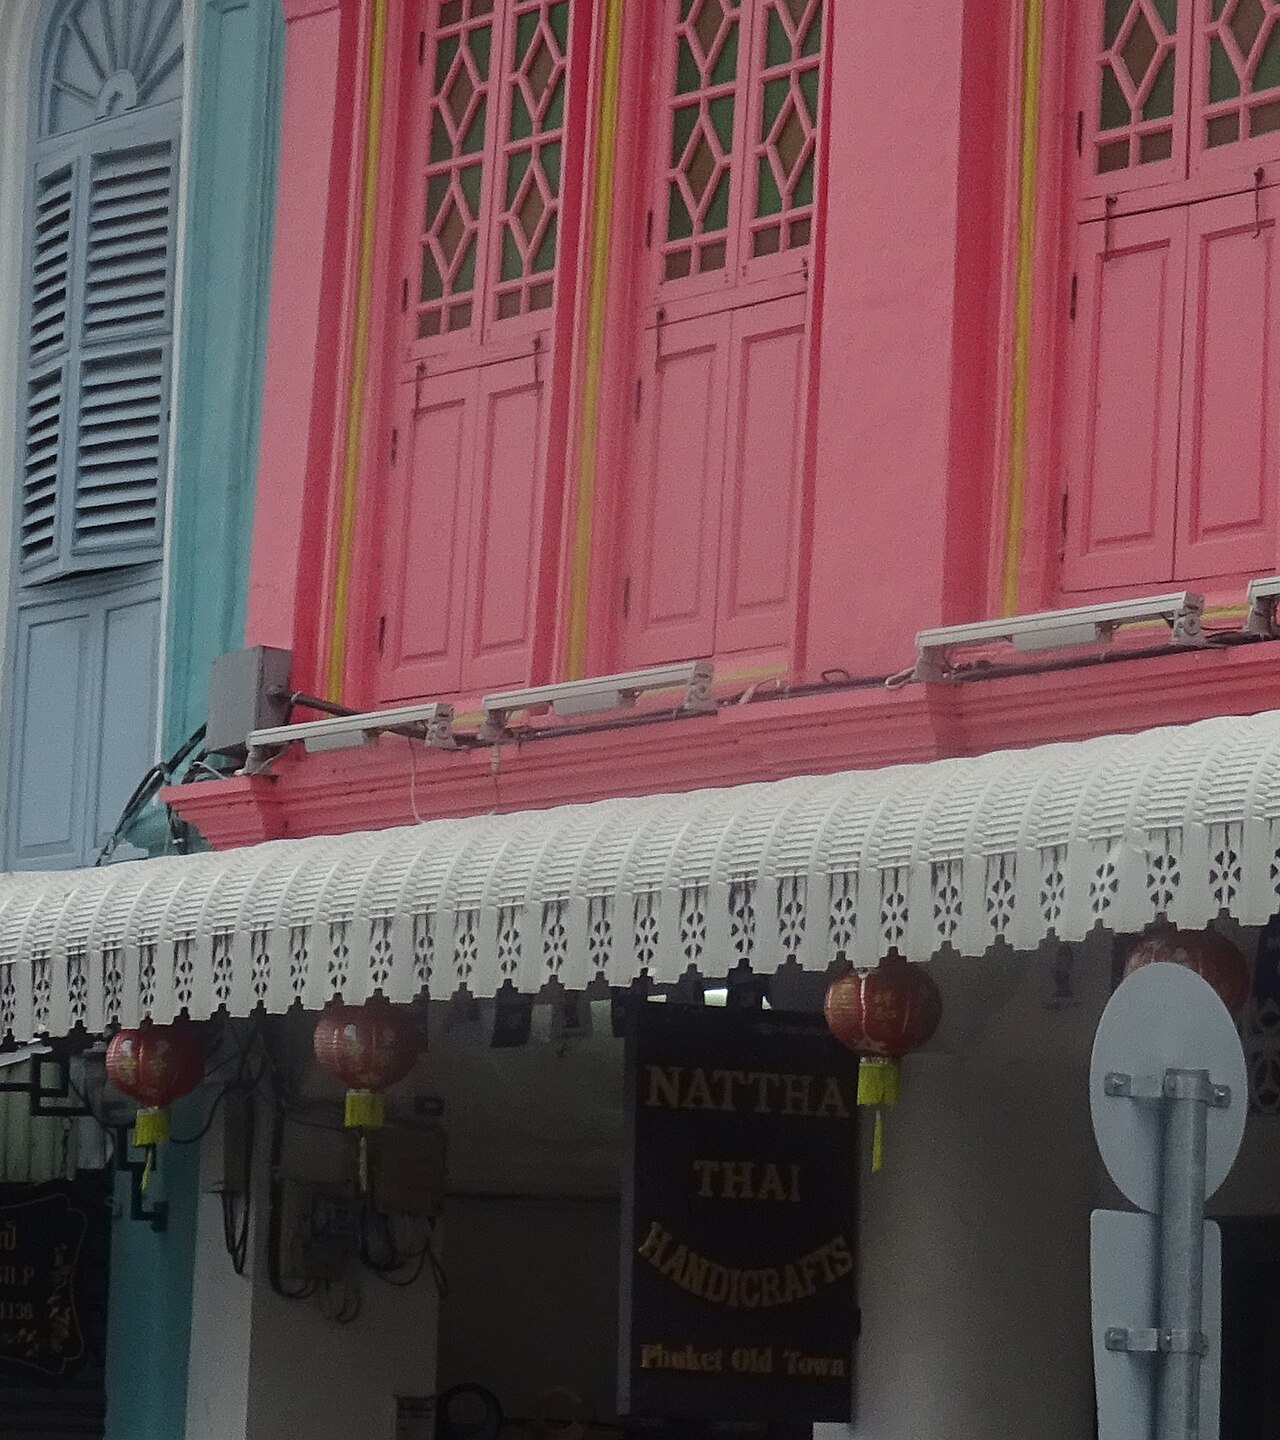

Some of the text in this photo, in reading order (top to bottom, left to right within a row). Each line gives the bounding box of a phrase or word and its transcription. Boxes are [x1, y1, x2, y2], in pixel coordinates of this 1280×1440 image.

[645, 1065, 850, 1118] NATTHA
[692, 1158, 801, 1203] THAI
[638, 1221, 852, 1308] HANDICRAFTS
[640, 1343, 846, 1377] Phuket Old Town
